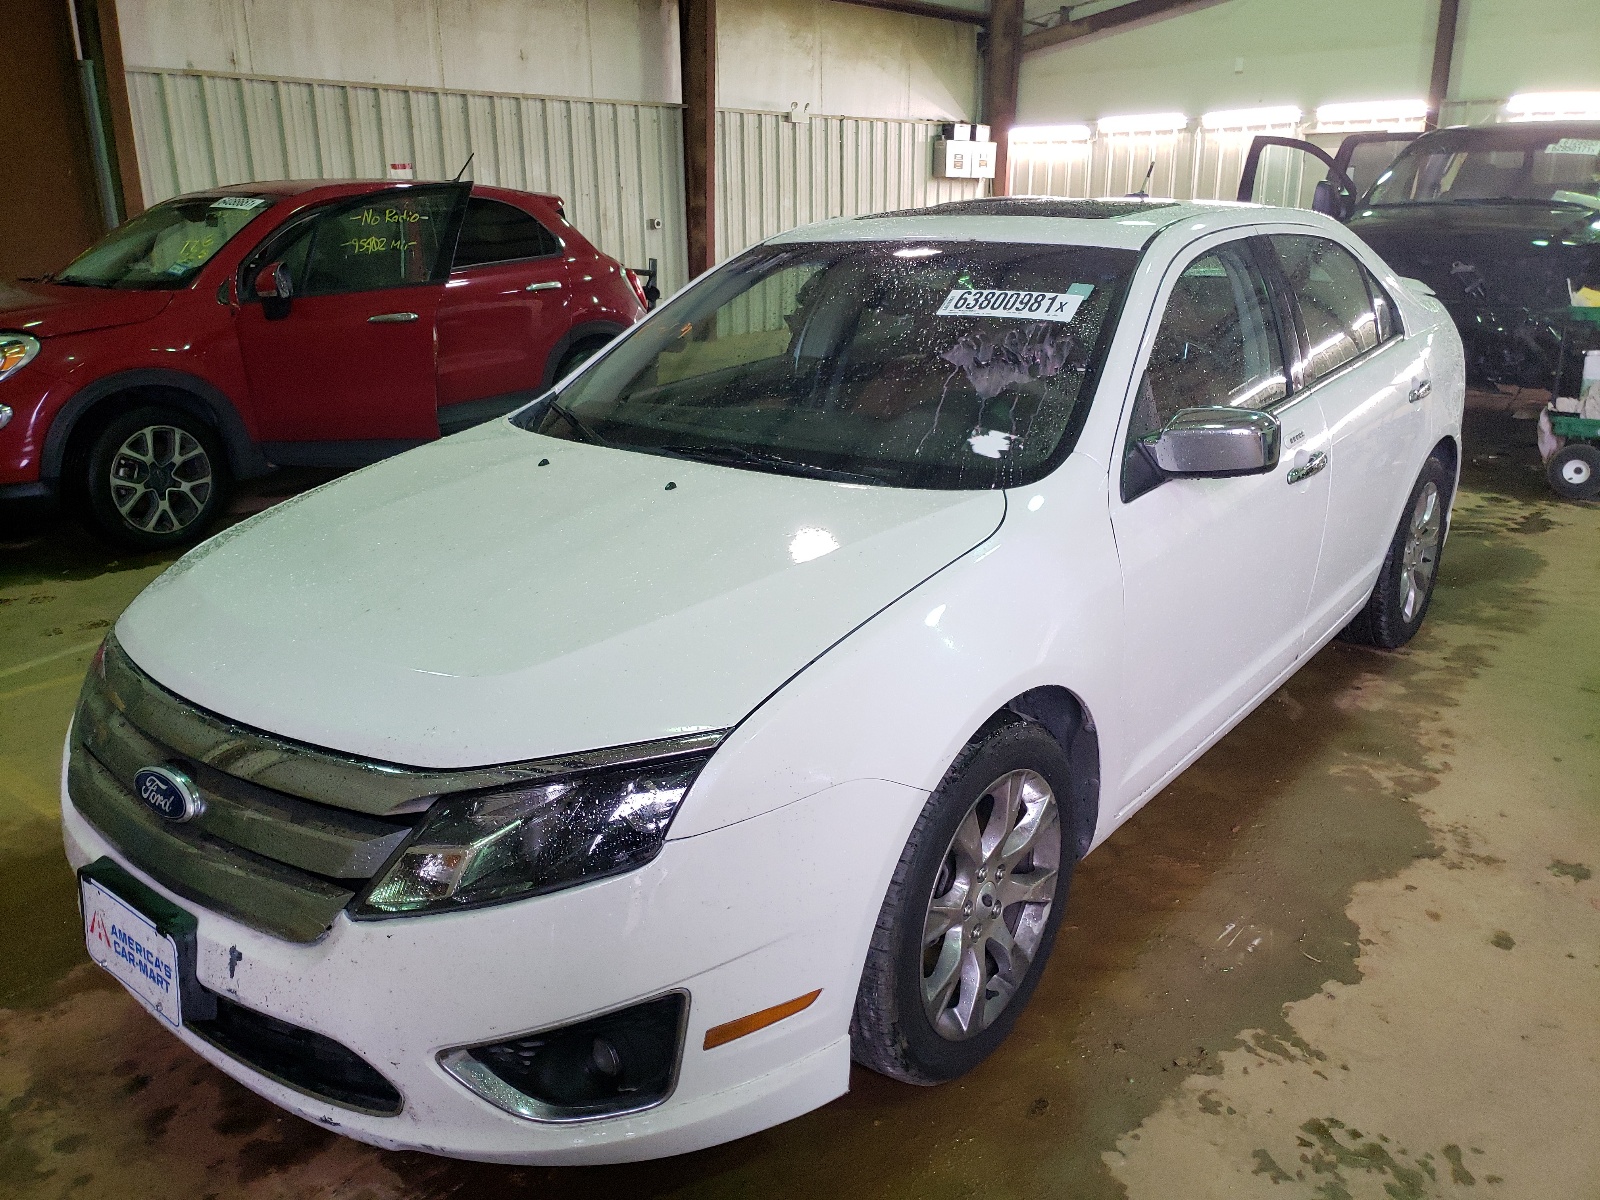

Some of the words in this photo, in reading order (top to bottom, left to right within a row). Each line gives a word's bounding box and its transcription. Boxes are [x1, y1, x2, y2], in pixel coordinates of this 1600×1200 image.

[141, 776, 175, 812] Ford
[111, 924, 172, 980] AMERICA'S
[113, 940, 170, 994] CAR-MART
